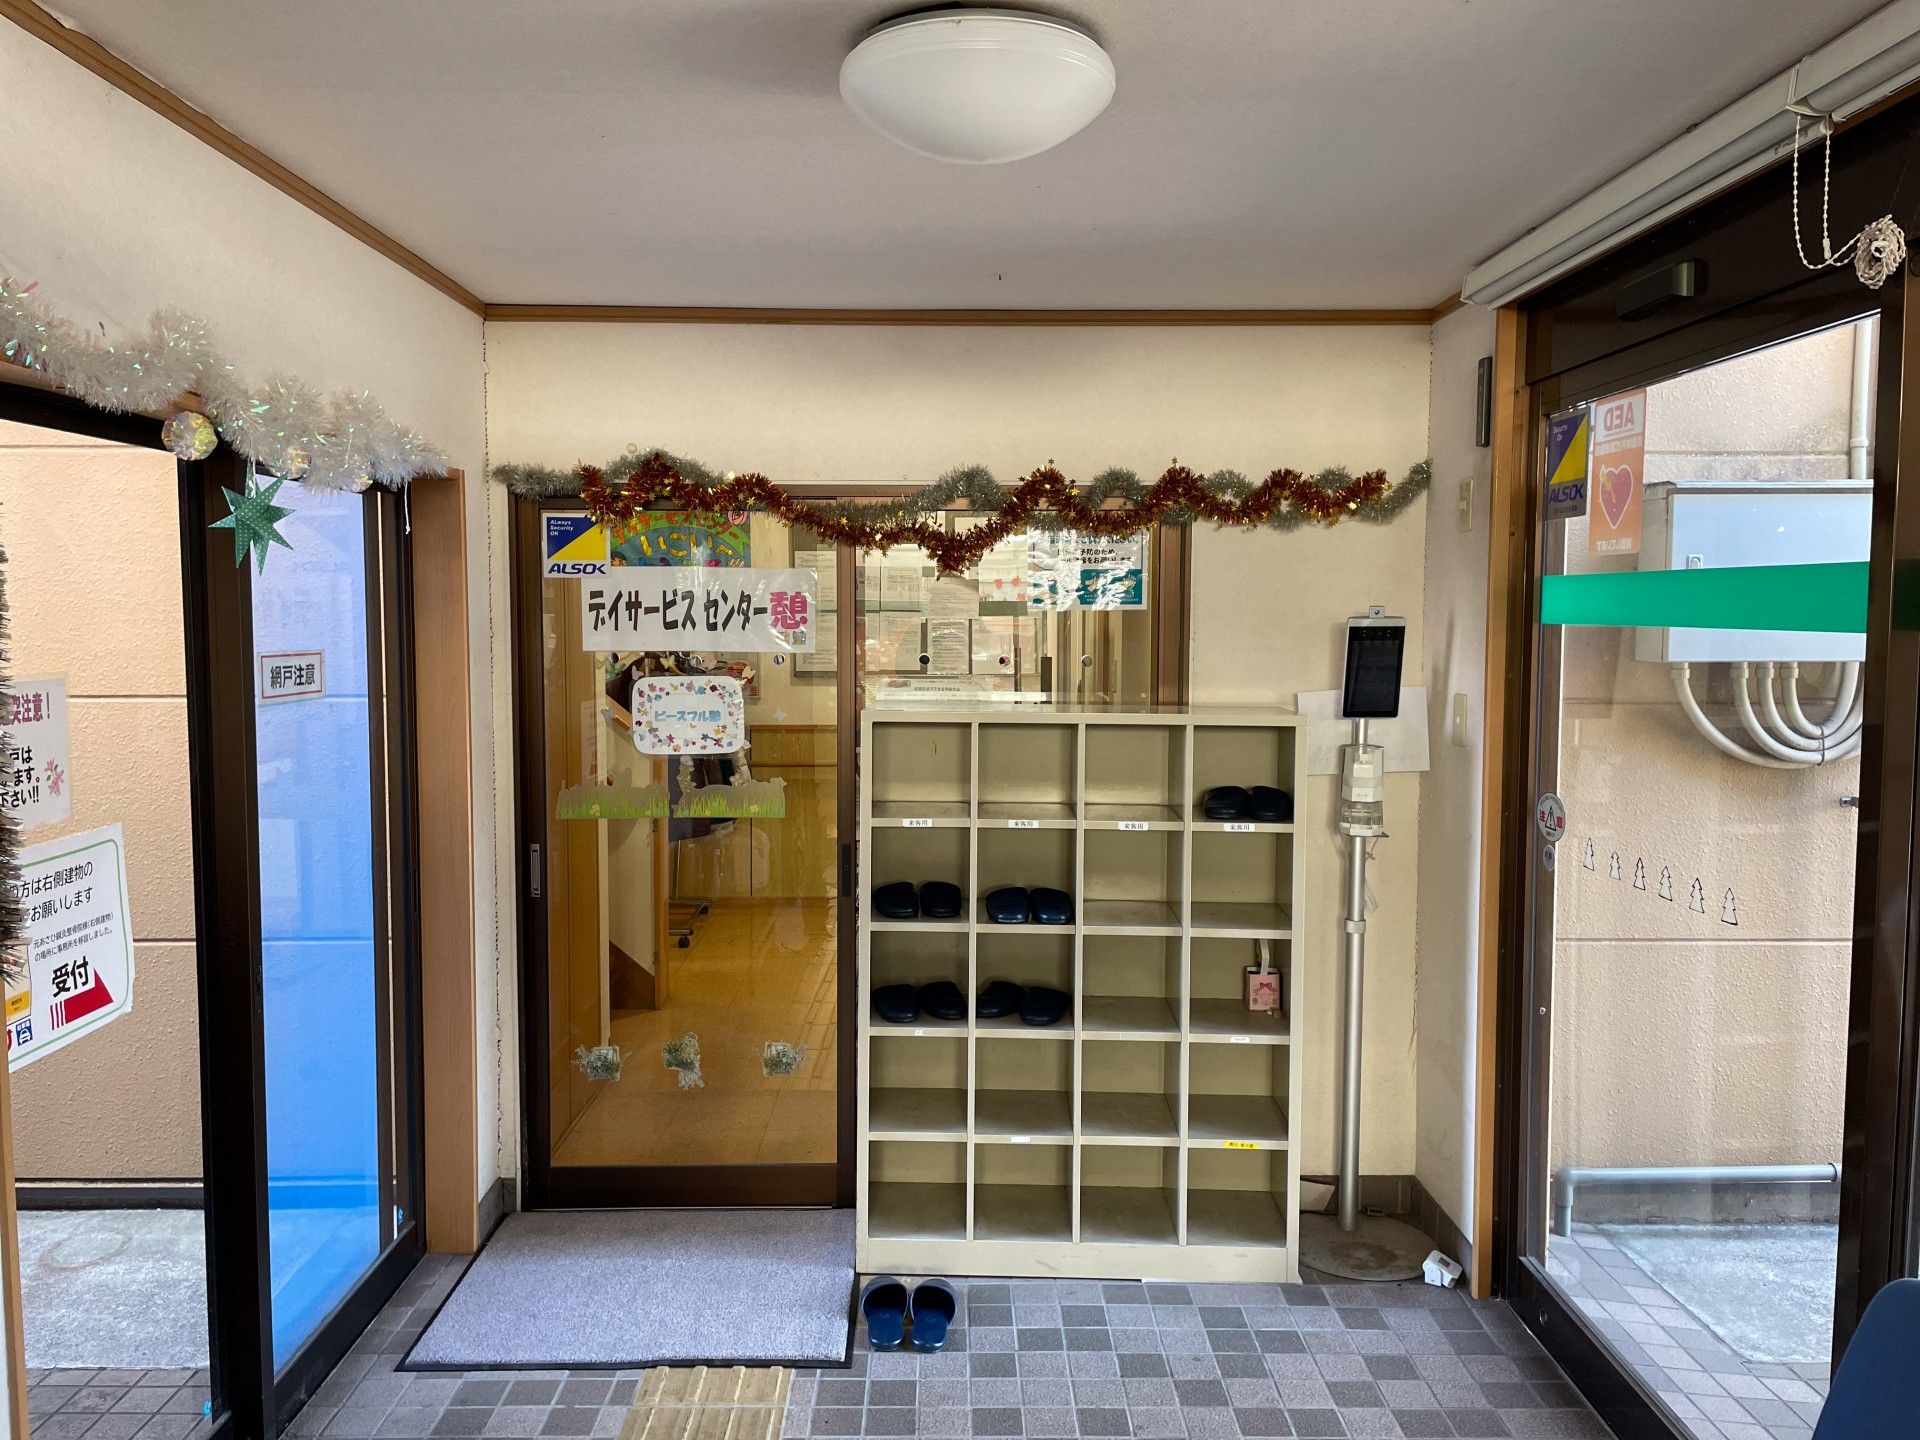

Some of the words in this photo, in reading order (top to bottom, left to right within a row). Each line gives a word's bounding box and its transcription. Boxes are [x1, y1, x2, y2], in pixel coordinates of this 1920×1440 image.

[1549, 483, 1584, 503] ALSOK
[548, 563, 607, 575] ALSOK
[270, 663, 316, 690] 網戸注意
[27, 886, 93, 922] お願いします
[51, 955, 89, 998] 受付
